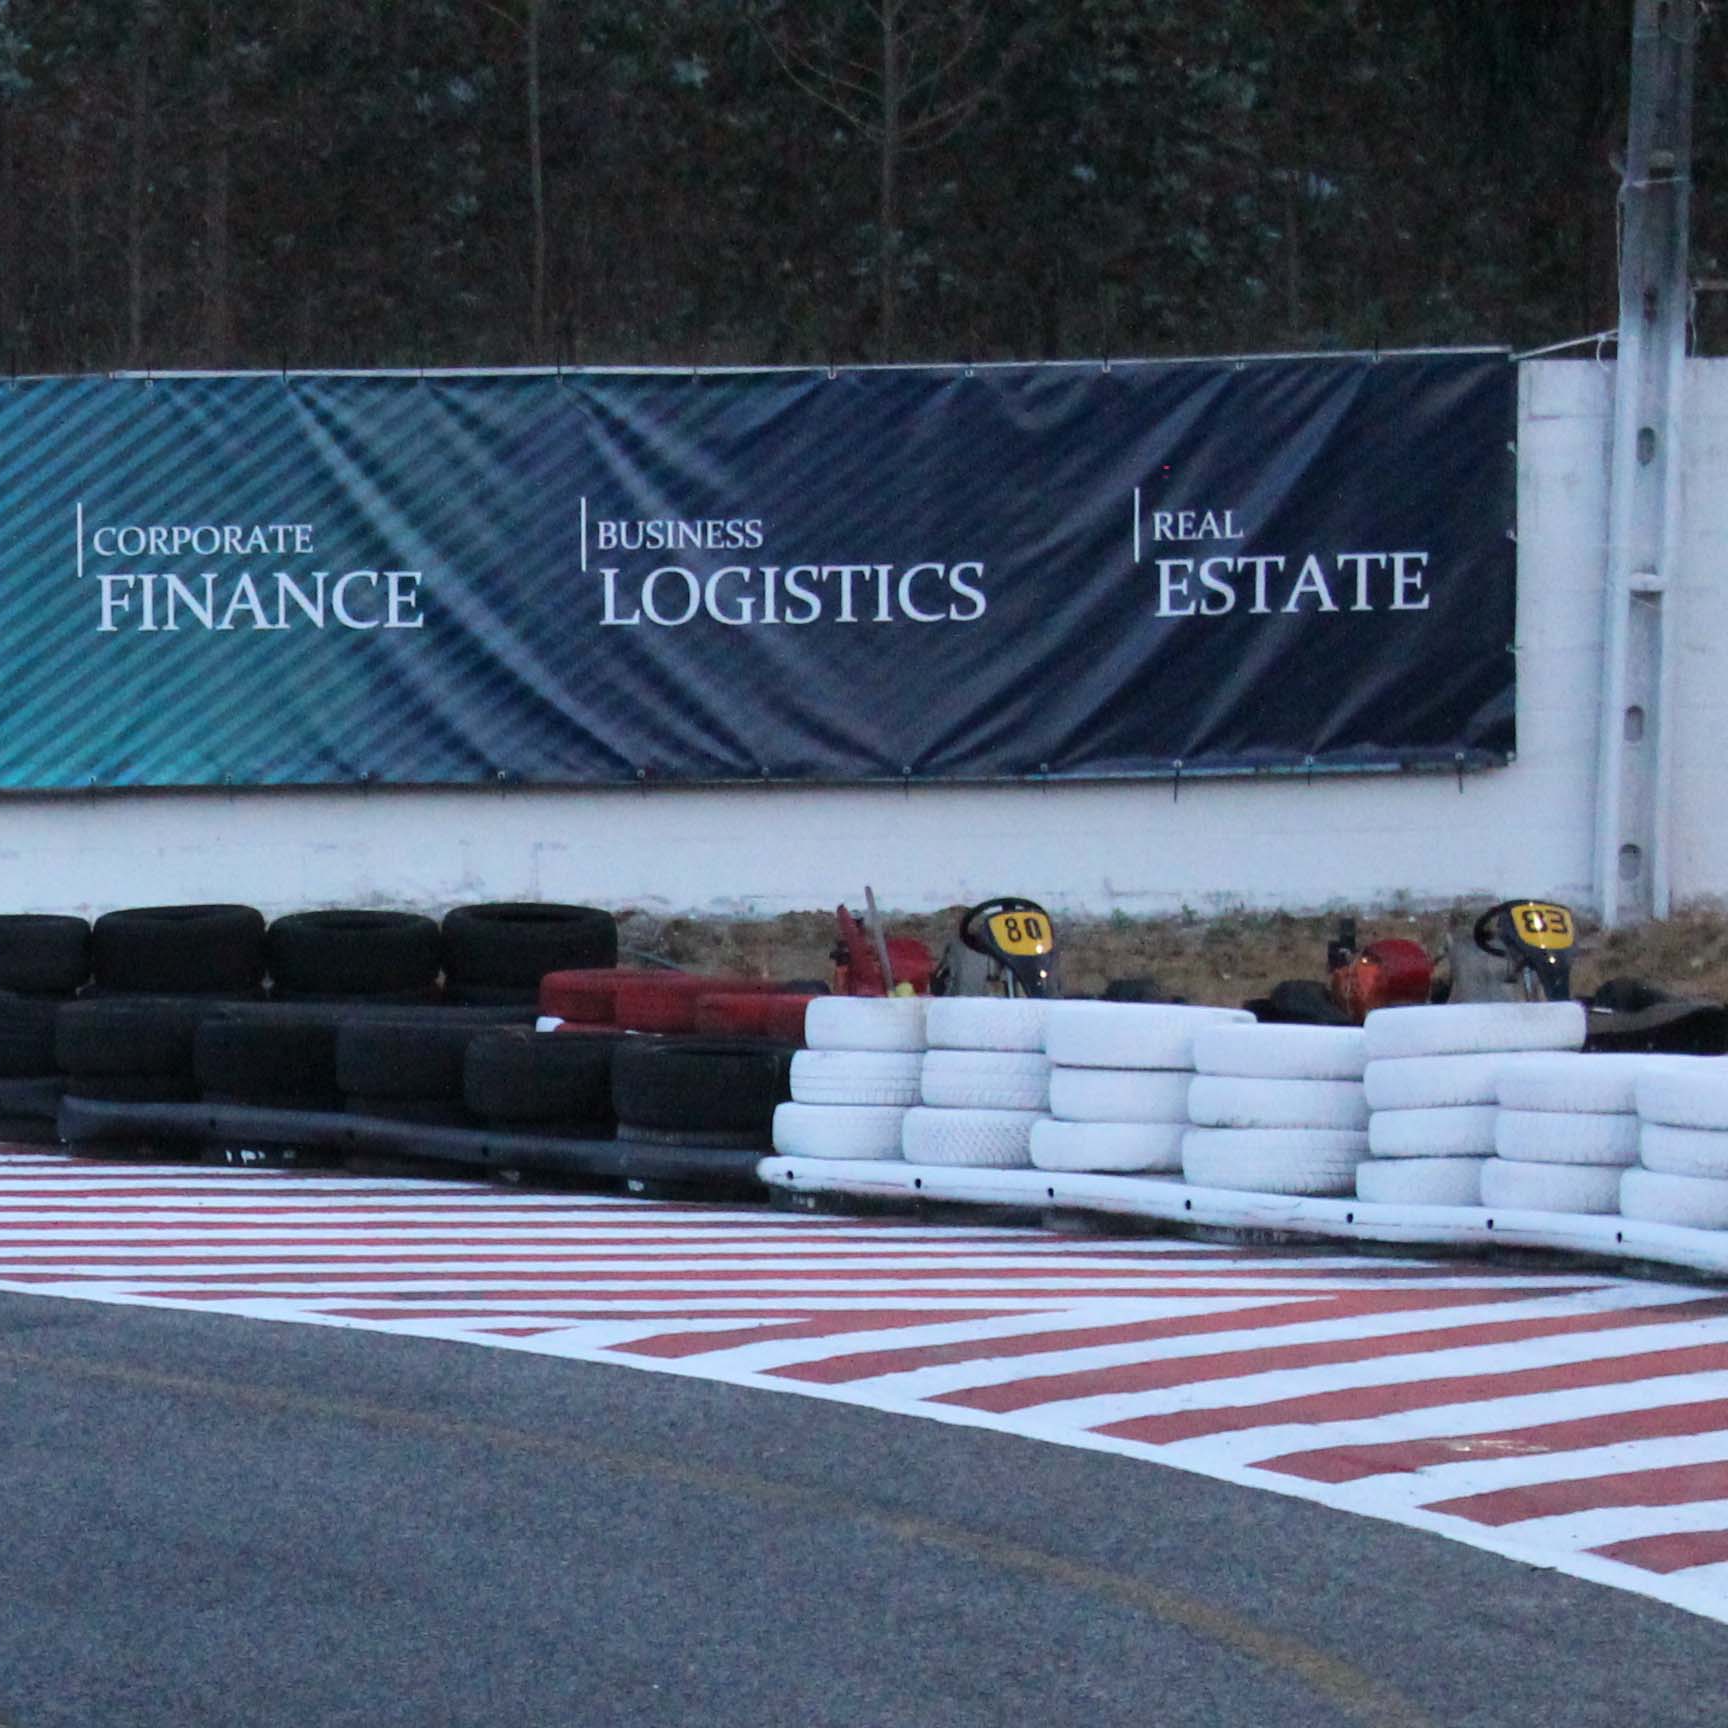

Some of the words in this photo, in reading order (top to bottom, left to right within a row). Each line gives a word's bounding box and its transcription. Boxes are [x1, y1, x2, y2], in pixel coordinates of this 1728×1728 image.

[93, 524, 315, 557] CORPORATE
[597, 519, 764, 550] BUSINESS
[1153, 510, 1244, 541] REAL
[96, 570, 424, 631] FINANCE
[599, 561, 987, 626] LOGISTICS
[1155, 552, 1430, 617] ESTATE
[1005, 917, 1042, 942] 80
